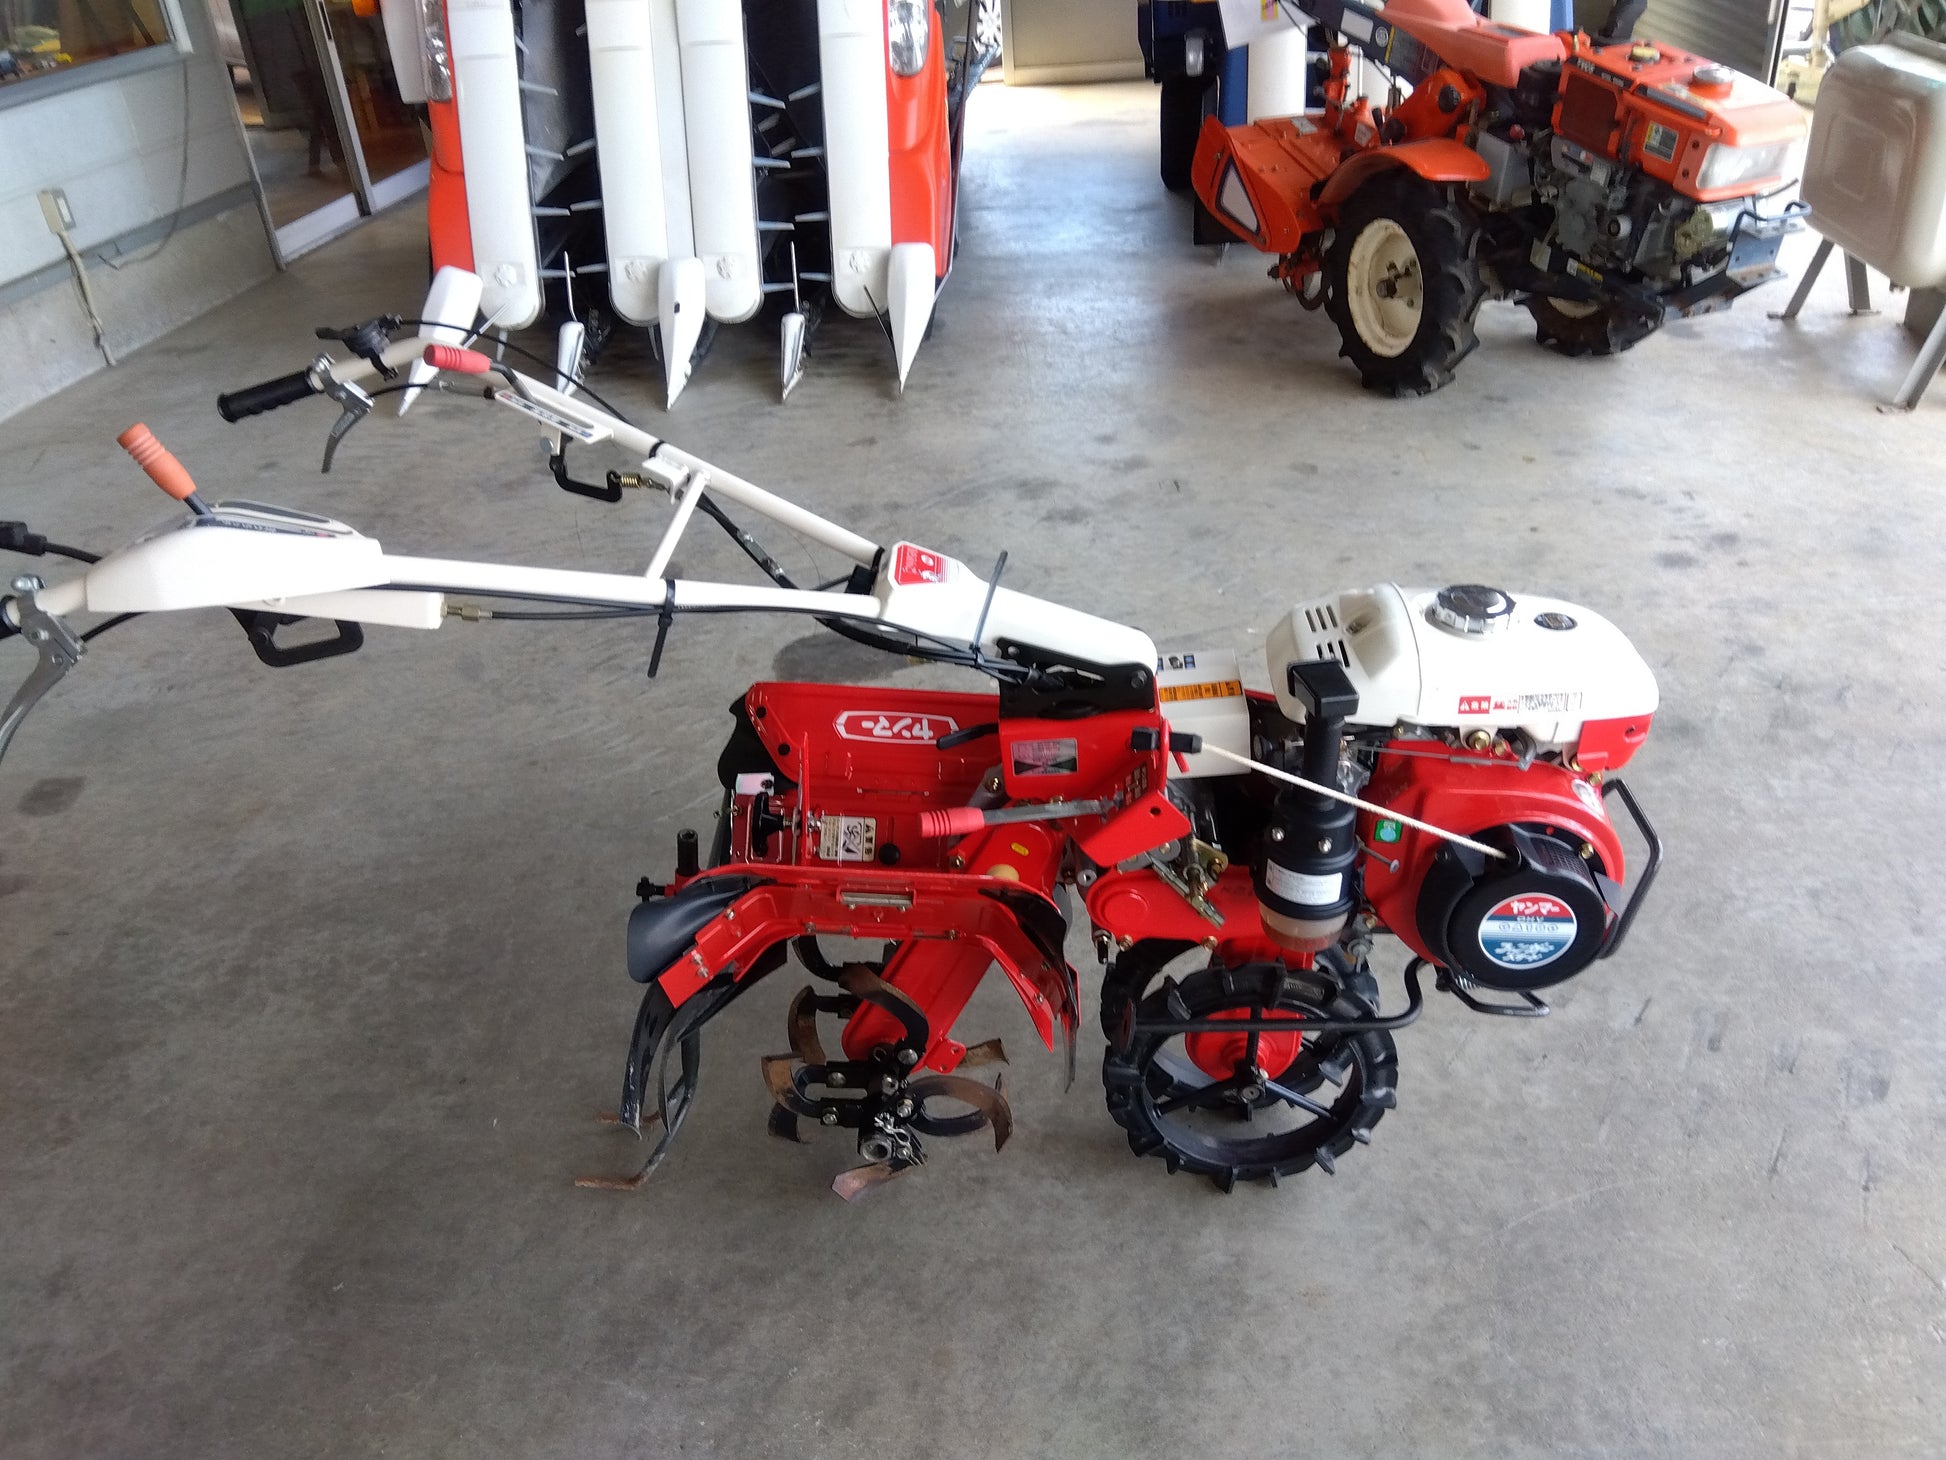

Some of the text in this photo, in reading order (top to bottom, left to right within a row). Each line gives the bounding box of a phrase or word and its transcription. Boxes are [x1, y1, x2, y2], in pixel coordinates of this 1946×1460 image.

[861, 715, 934, 740] ヤンマー
[1511, 900, 1560, 915] ヤンマー
